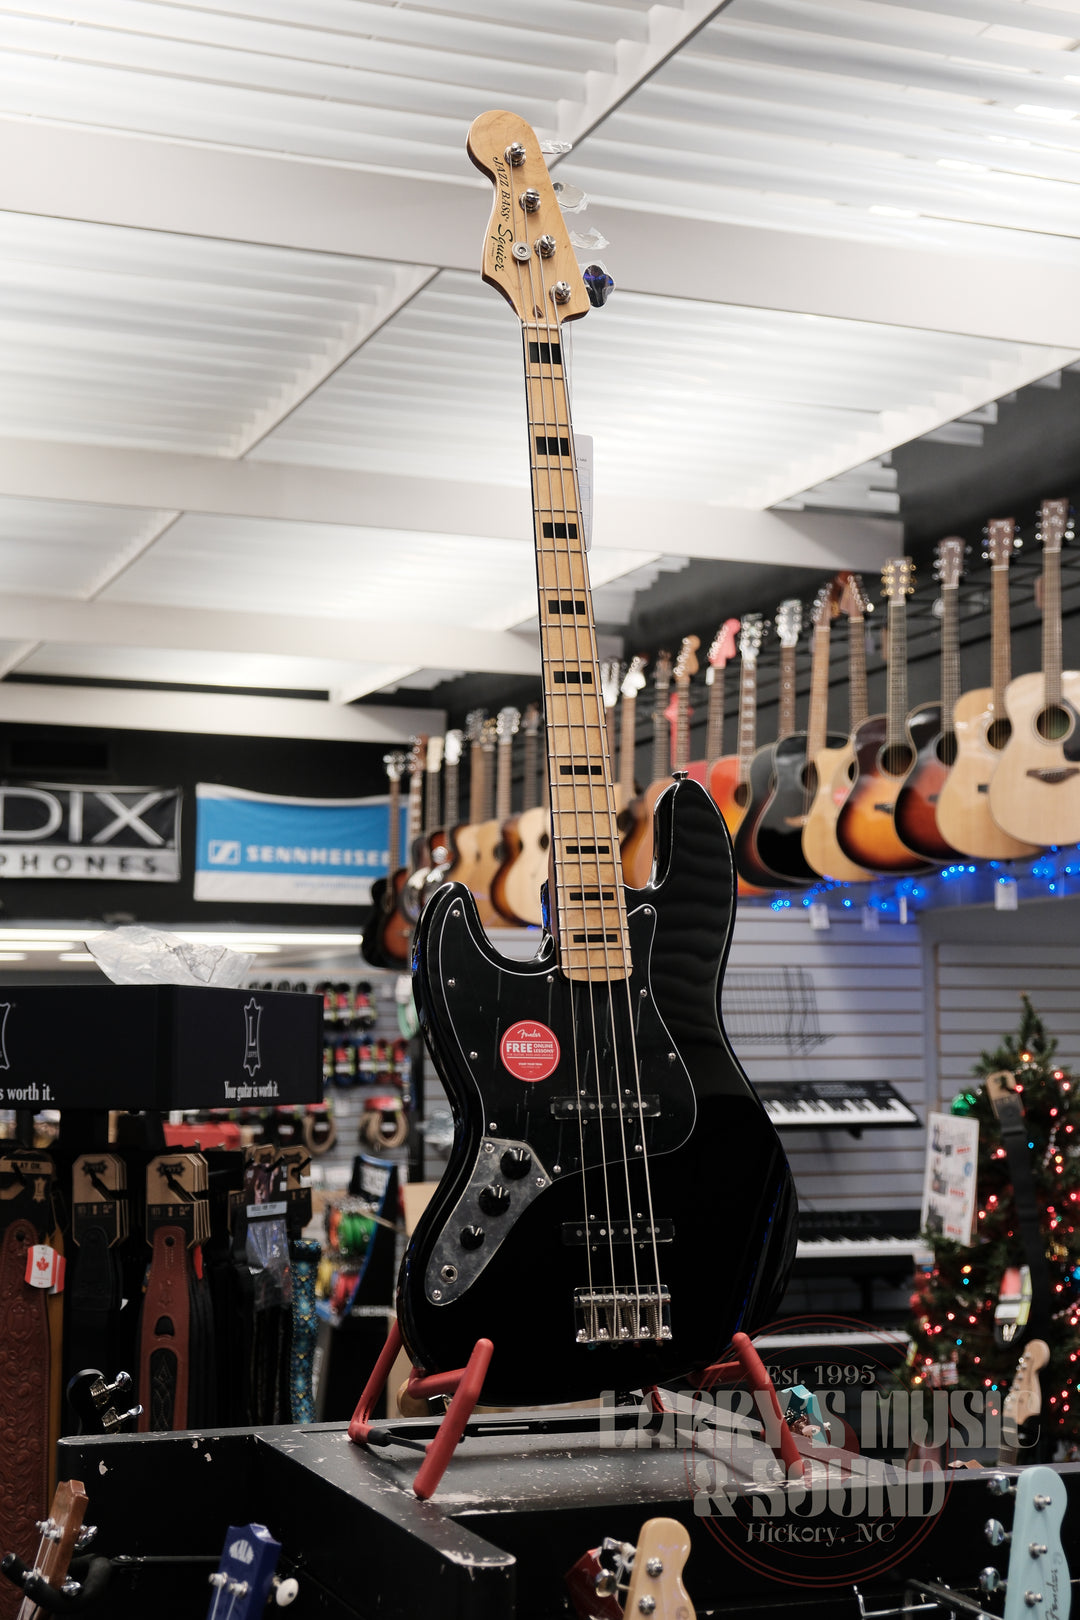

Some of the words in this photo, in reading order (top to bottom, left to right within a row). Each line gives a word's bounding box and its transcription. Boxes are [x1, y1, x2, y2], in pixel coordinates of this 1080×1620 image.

[493, 156, 510, 188] JAZZ
[501, 190, 511, 221] BASS
[490, 223, 513, 272] Squier
[517, 1029, 541, 1039] Fender
[506, 1042, 533, 1053] FREE
[7, 1082, 39, 1101] worth
[42, 1083, 55, 1101] it.
[224, 1081, 237, 1099] Your
[237, 1081, 252, 1101] guitar
[252, 1081, 258, 1098] is
[259, 1080, 272, 1098] worth
